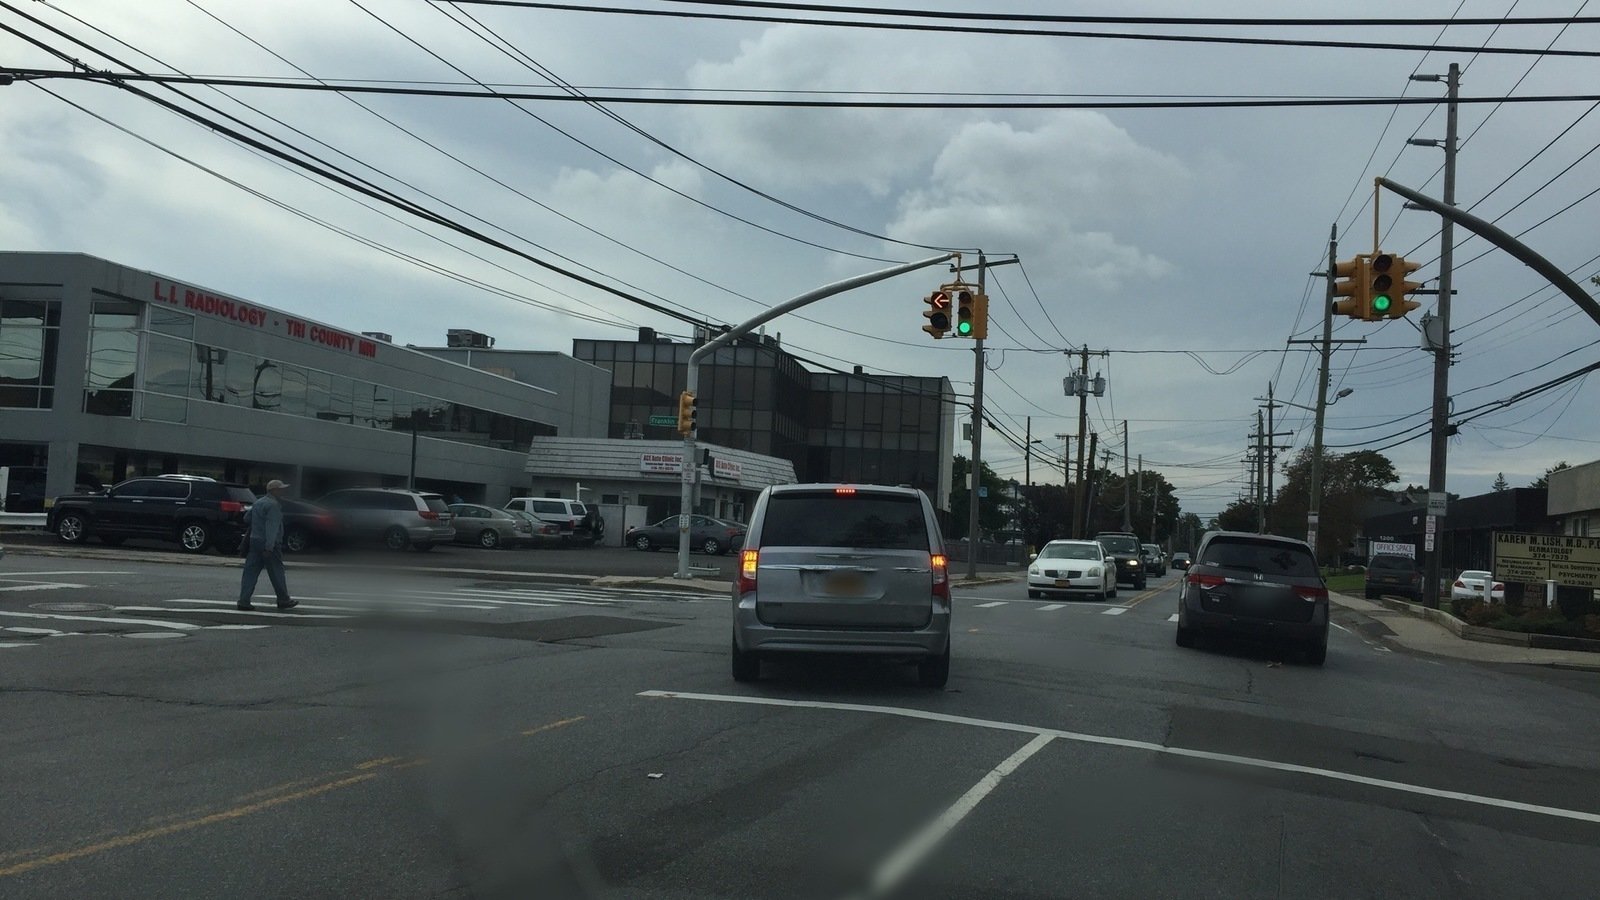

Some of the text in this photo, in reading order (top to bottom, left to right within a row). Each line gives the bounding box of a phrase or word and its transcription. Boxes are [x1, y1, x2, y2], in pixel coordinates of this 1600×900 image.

[185, 289, 266, 328] RADIOLOGY
[286, 318, 305, 339] TRI
[310, 325, 355, 351] COUNTY
[651, 417, 675, 425] Franklin
[1498, 534, 1526, 545] KAREN
[1530, 536, 1540, 546] M.
[1376, 543, 1413, 552] OFFICE SPACE
[1528, 546, 1573, 555] DERMATOLOGY
[1558, 572, 1598, 580] PSYCHIATRY
